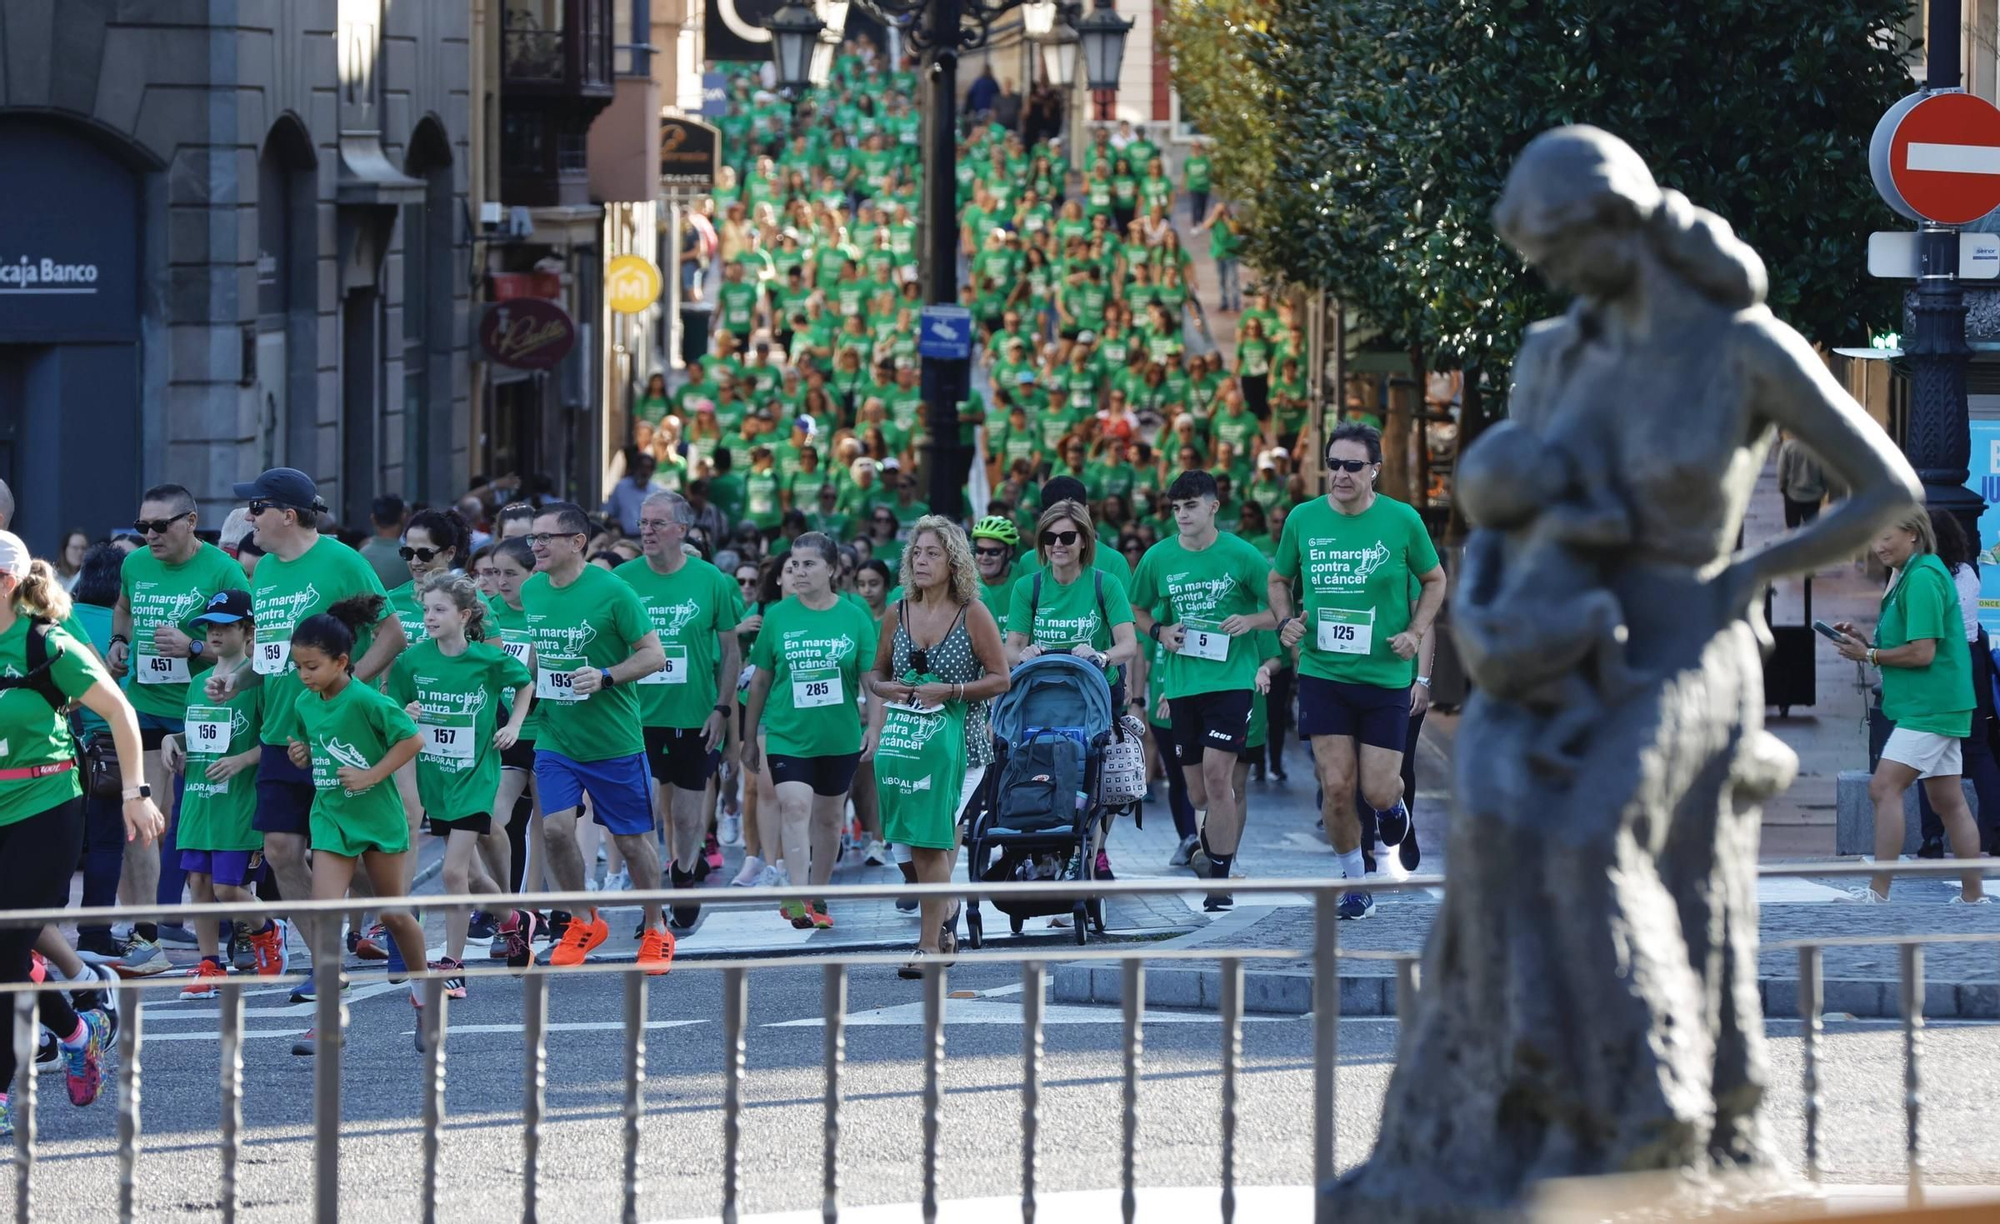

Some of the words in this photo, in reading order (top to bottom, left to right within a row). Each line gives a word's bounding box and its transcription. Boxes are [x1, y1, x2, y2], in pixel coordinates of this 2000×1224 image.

[0, 254, 39, 288] caja
[40, 257, 98, 283] Banco
[1981, 475, 2000, 504] JU
[1309, 548, 1326, 561] En
[1329, 547, 1378, 560] marcha
[1310, 561, 1351, 573] contra
[1311, 573, 1321, 585] el
[1323, 572, 1368, 585] cáncer
[1168, 582, 1183, 595] En
[133, 591, 147, 603] En
[131, 604, 165, 616] contra
[254, 598, 267, 612] En
[1185, 600, 1217, 611] cáncer
[133, 616, 141, 627] el
[656, 627, 681, 637] ncer
[1033, 628, 1067, 639] contra
[1332, 624, 1355, 641] 125
[784, 640, 799, 650] En
[1198, 633, 1208, 647] 5
[264, 644, 281, 661] 159
[785, 648, 822, 660] contra
[150, 658, 173, 672] 457
[798, 658, 838, 669] cáncer
[805, 682, 829, 697] 285
[198, 724, 217, 739] 156
[433, 728, 456, 744] 157
[1208, 729, 1232, 741] Zeus
[885, 734, 924, 750] cáncer
